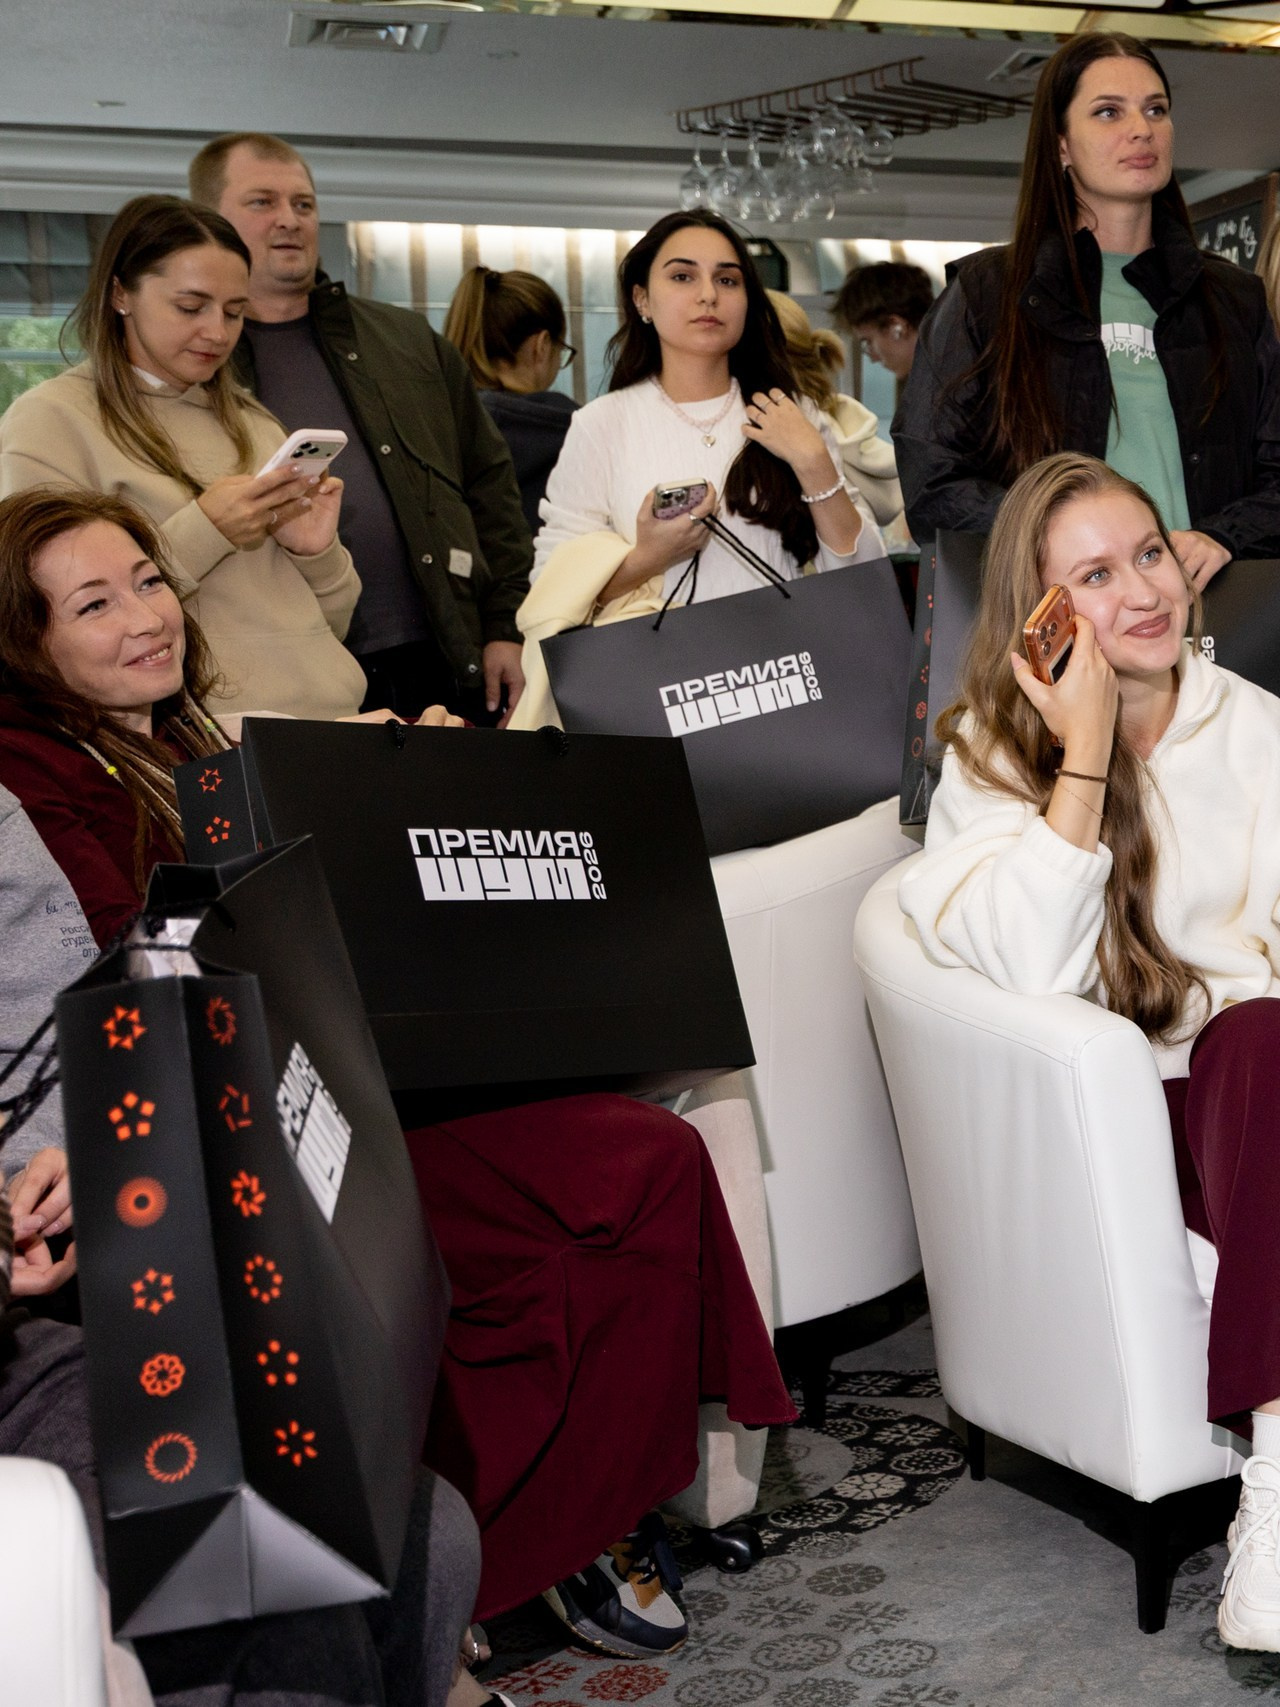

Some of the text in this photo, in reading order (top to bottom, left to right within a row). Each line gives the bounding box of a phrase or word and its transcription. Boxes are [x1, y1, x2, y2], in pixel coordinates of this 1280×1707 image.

[1201, 635, 1216, 662] 26
[658, 653, 801, 707] ПРЕМИЯ
[797, 650, 824, 701] 2026
[664, 673, 810, 737] ШУМ
[407, 828, 581, 857] ПРЕМИЯ
[578, 831, 608, 900] 2026
[414, 857, 592, 901] ШУМ
[82, 948, 100, 959] отр
